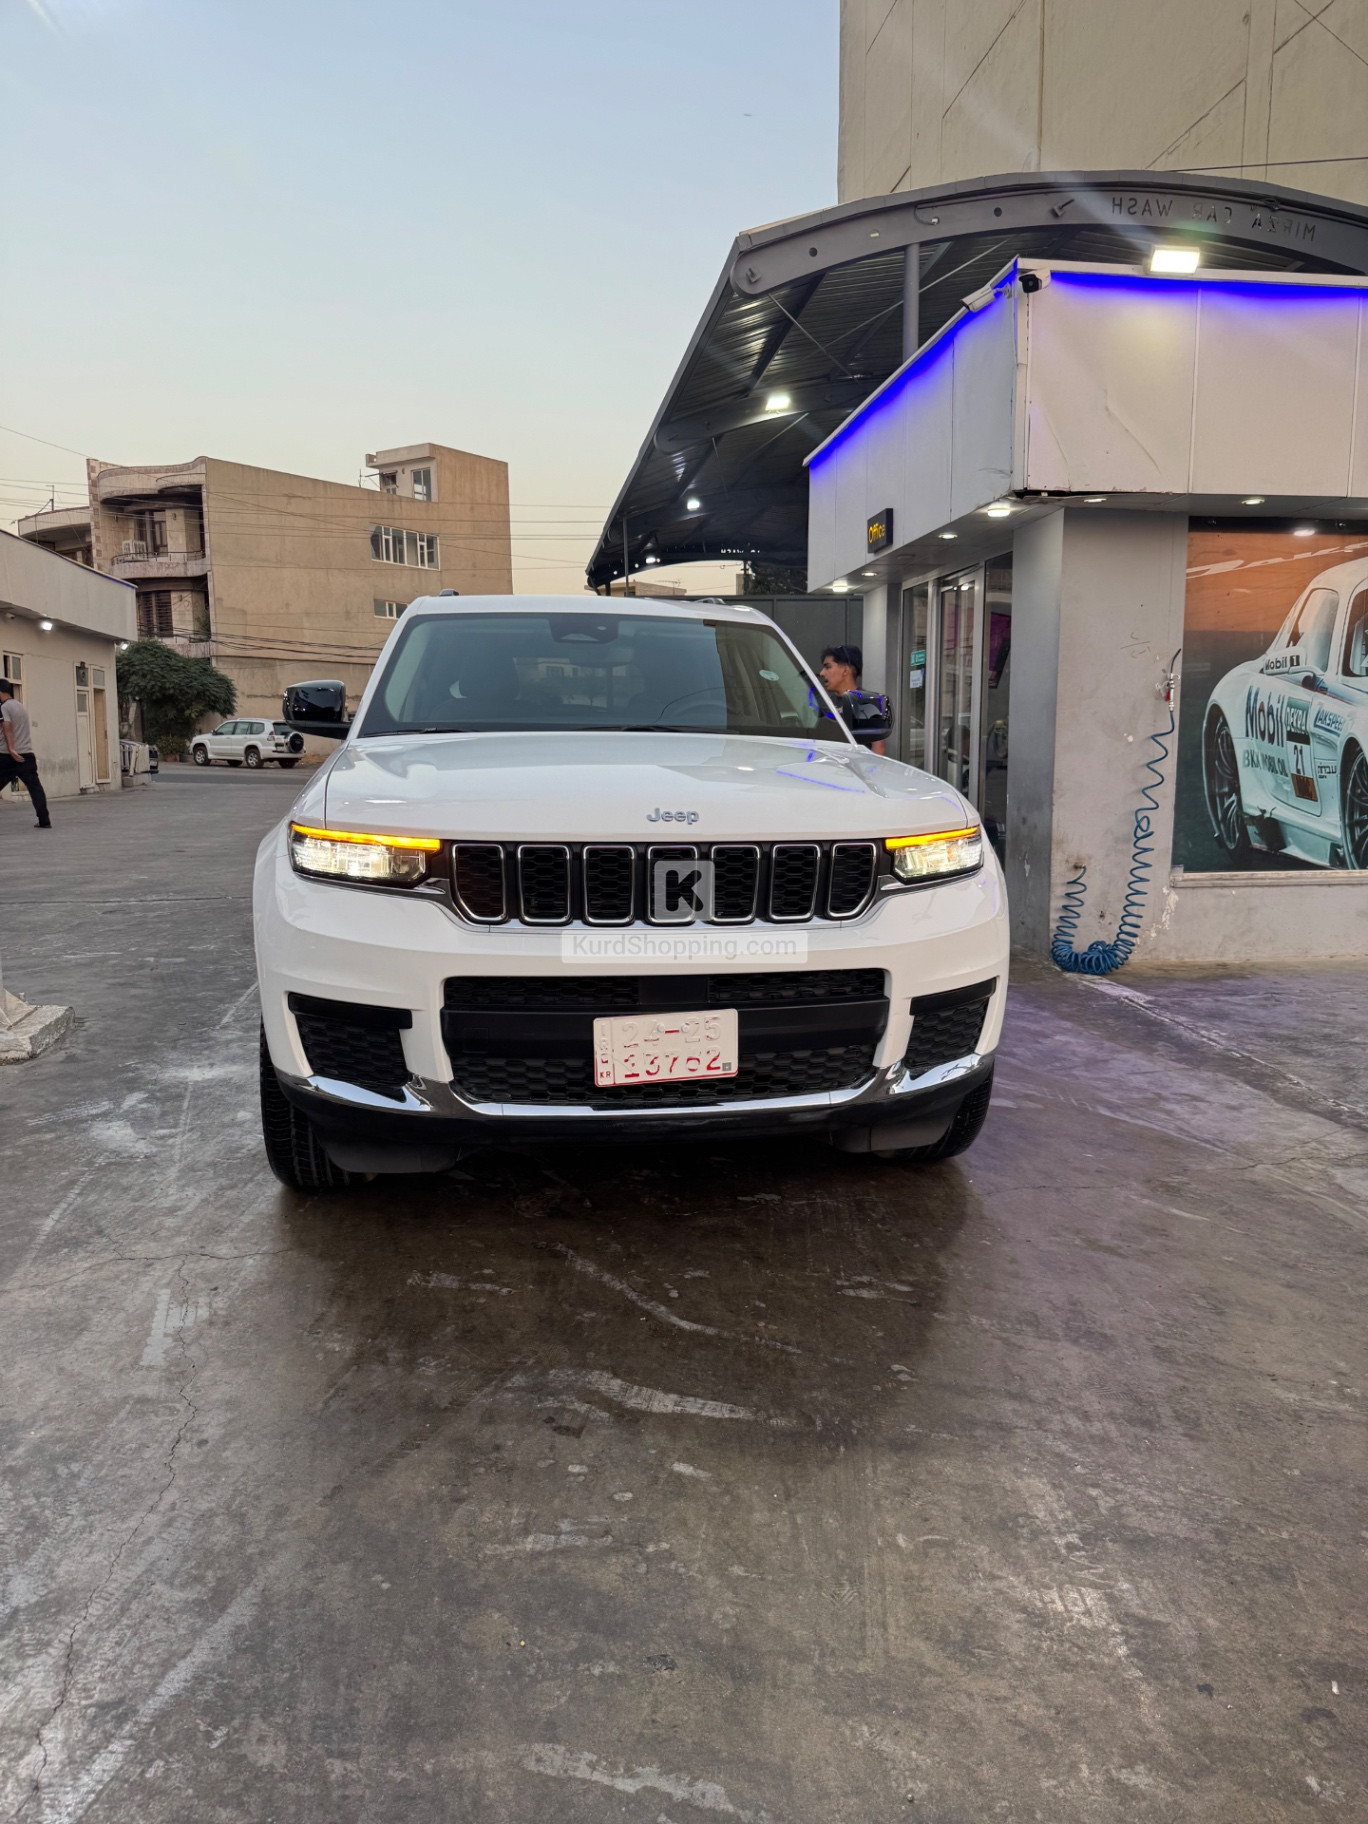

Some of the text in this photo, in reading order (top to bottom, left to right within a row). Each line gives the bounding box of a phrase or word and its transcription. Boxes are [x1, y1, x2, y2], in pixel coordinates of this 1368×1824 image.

[868, 522, 886, 544] Office
[1265, 655, 1300, 670] Mobil 1
[1246, 685, 1285, 748] Mobil
[1293, 744, 1306, 776] 21
[646, 808, 700, 825] Jeep
